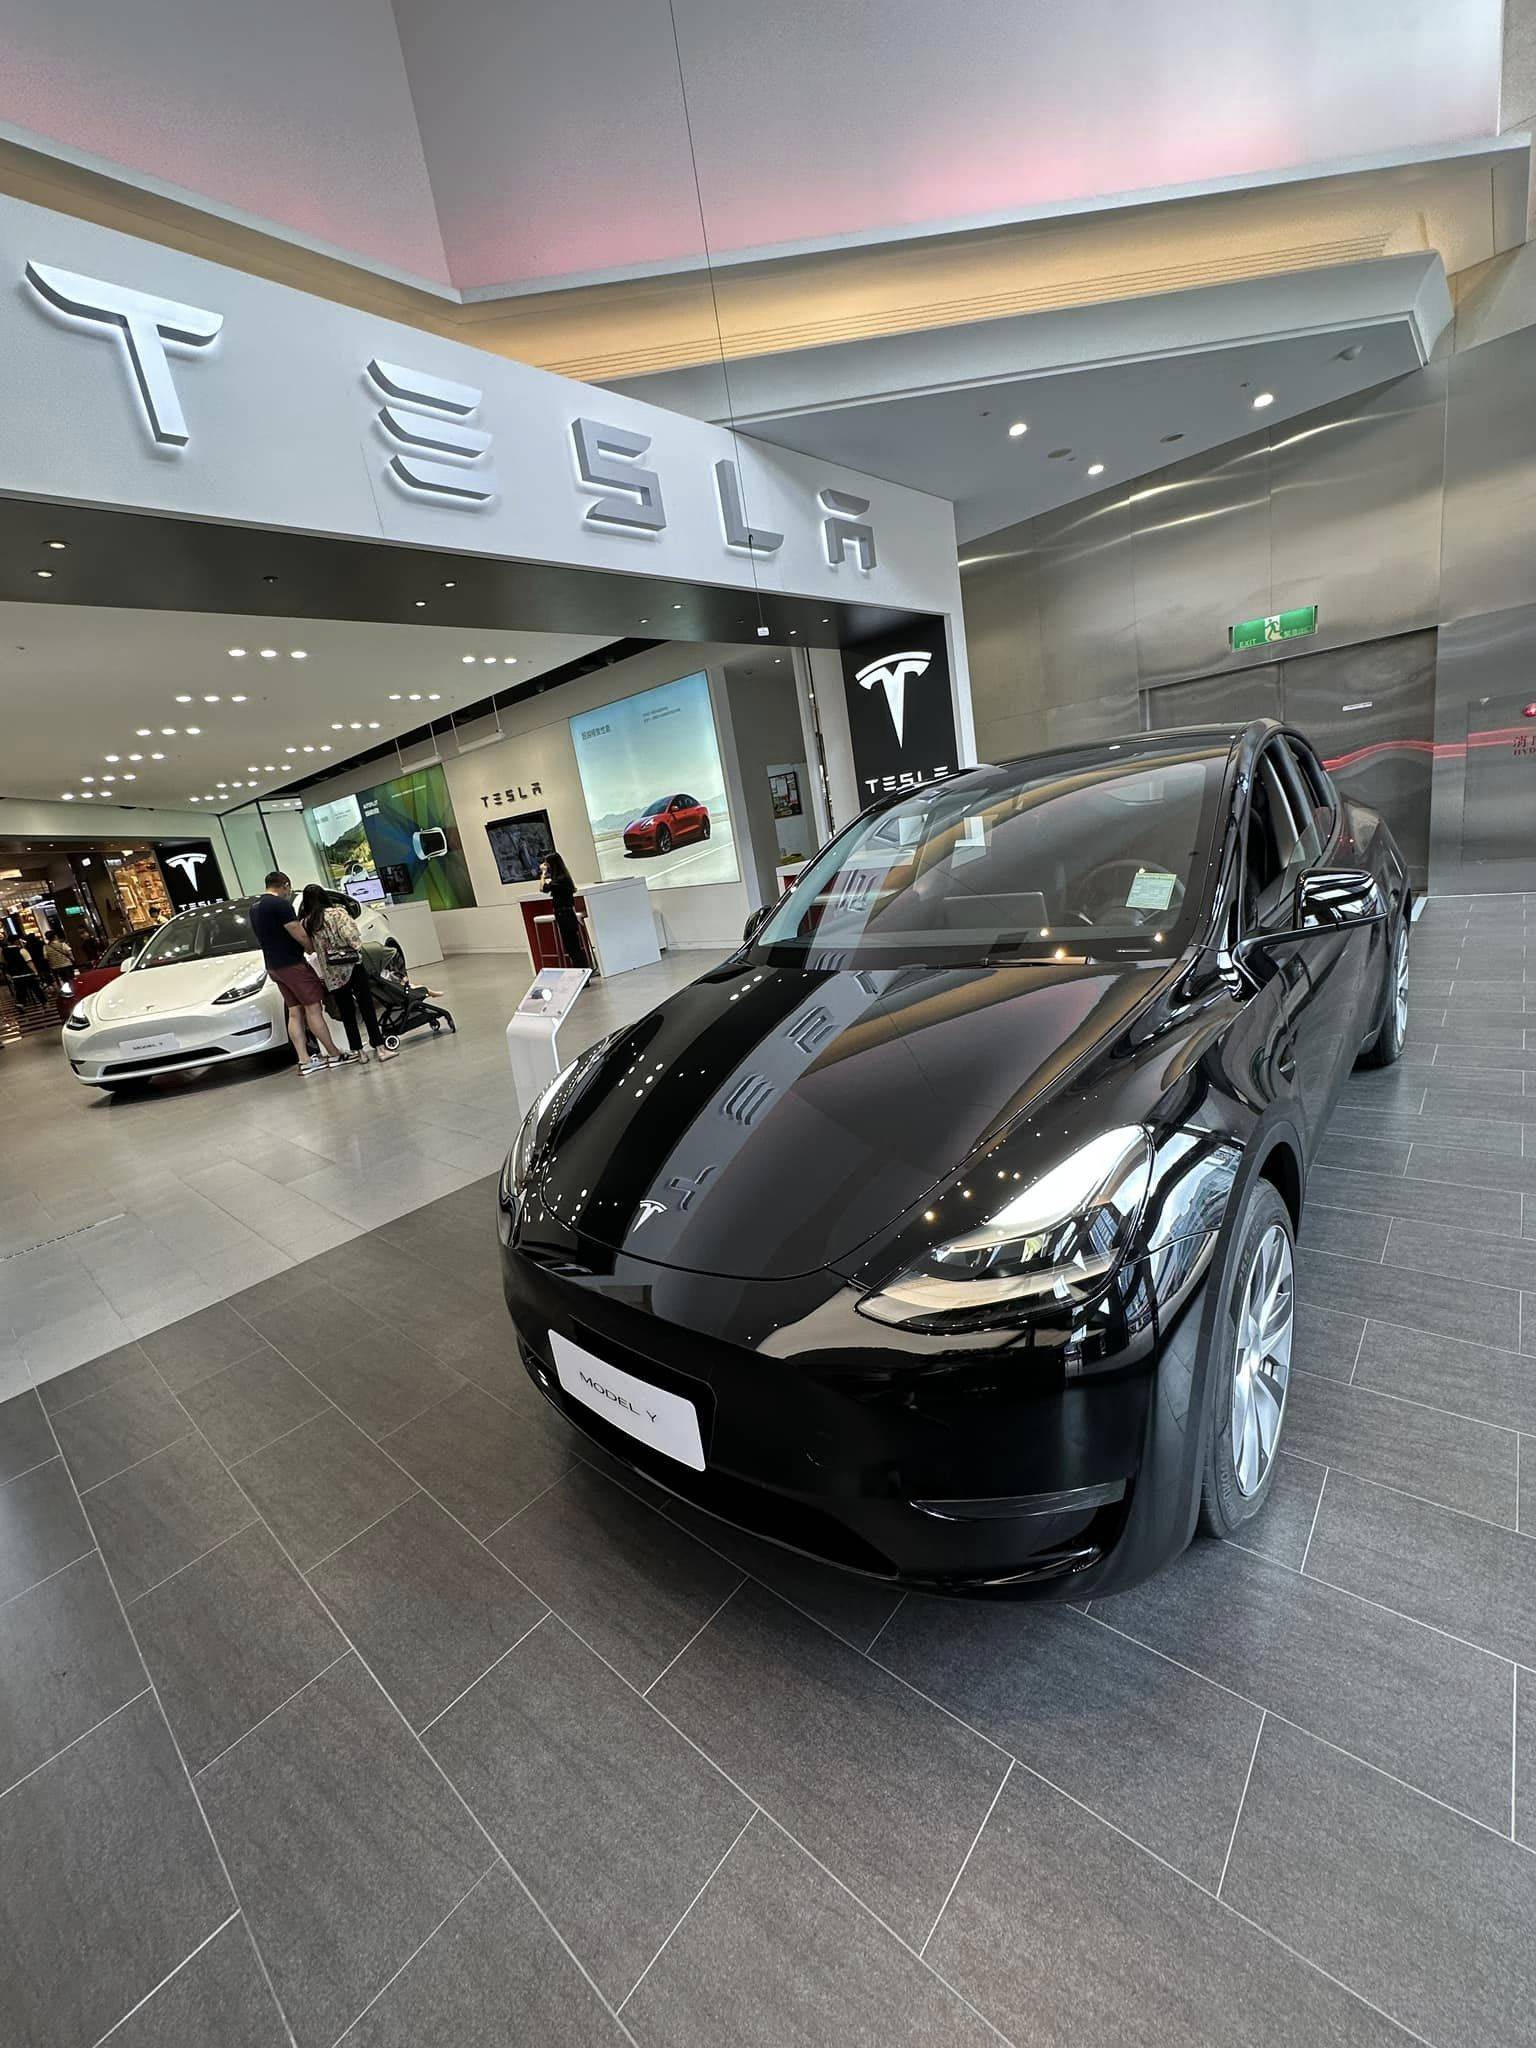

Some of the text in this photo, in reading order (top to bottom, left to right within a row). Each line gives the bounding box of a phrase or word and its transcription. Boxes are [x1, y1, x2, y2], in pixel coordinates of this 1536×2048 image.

[25, 260, 877, 571] TESLA
[480, 782, 542, 808] TESLA
[580, 1371, 657, 1423] MODEL Y
